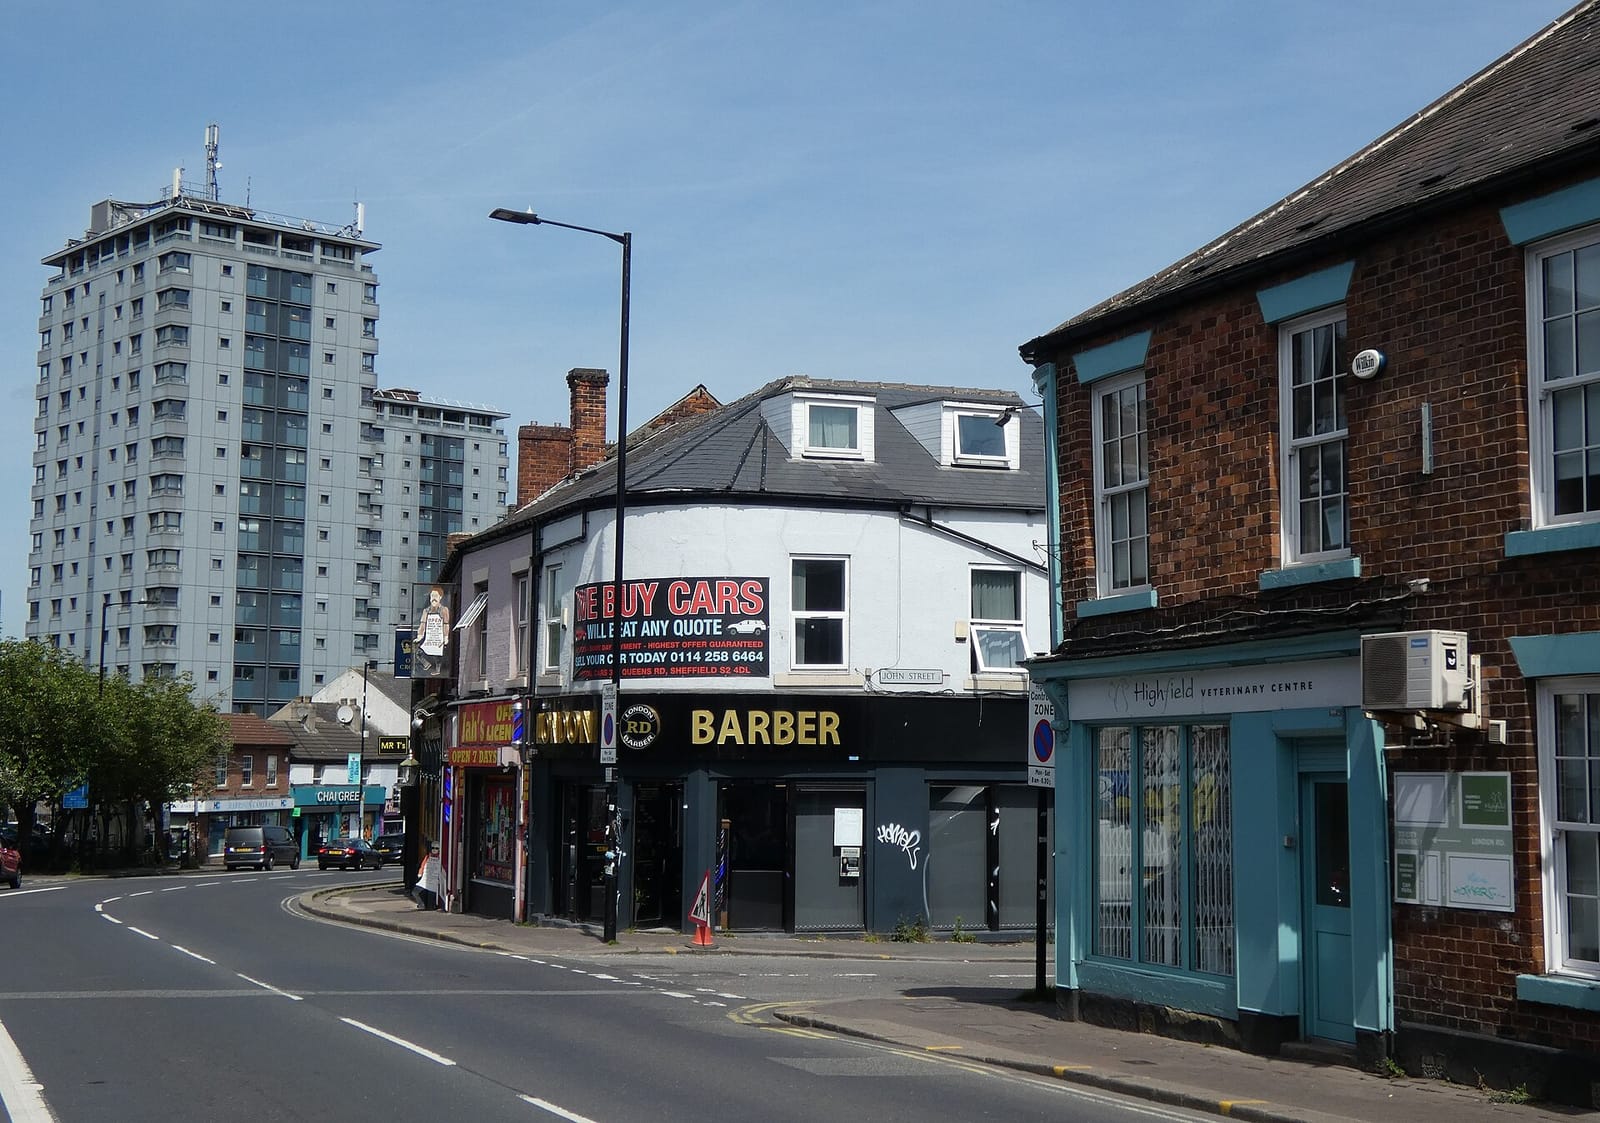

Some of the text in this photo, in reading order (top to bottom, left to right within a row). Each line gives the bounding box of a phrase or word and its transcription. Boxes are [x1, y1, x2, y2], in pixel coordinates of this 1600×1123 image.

[576, 580, 764, 622] WE BUY CARS
[587, 623, 606, 640] WILL
[640, 620, 669, 637] ANY
[674, 619, 722, 638] QUOTE
[587, 654, 604, 665] YOUR
[607, 653, 626, 664] CR
[629, 652, 668, 663] TODAY
[670, 651, 700, 662] 0114
[705, 651, 728, 662] 258
[732, 651, 764, 661] 6464
[734, 666, 750, 674] 4DL
[882, 672, 936, 680] JOHN STREET
[1134, 677, 1313, 714] Highfield VETERINARY CENTRE
[625, 705, 653, 720] LONDON
[1035, 704, 1054, 715] ZONE
[626, 721, 652, 734] RD
[692, 710, 840, 745] BARBER
[623, 734, 655, 748] BARBER
[452, 750, 496, 763] OPEN 7 DAYS
[317, 792, 336, 801] CHAI
